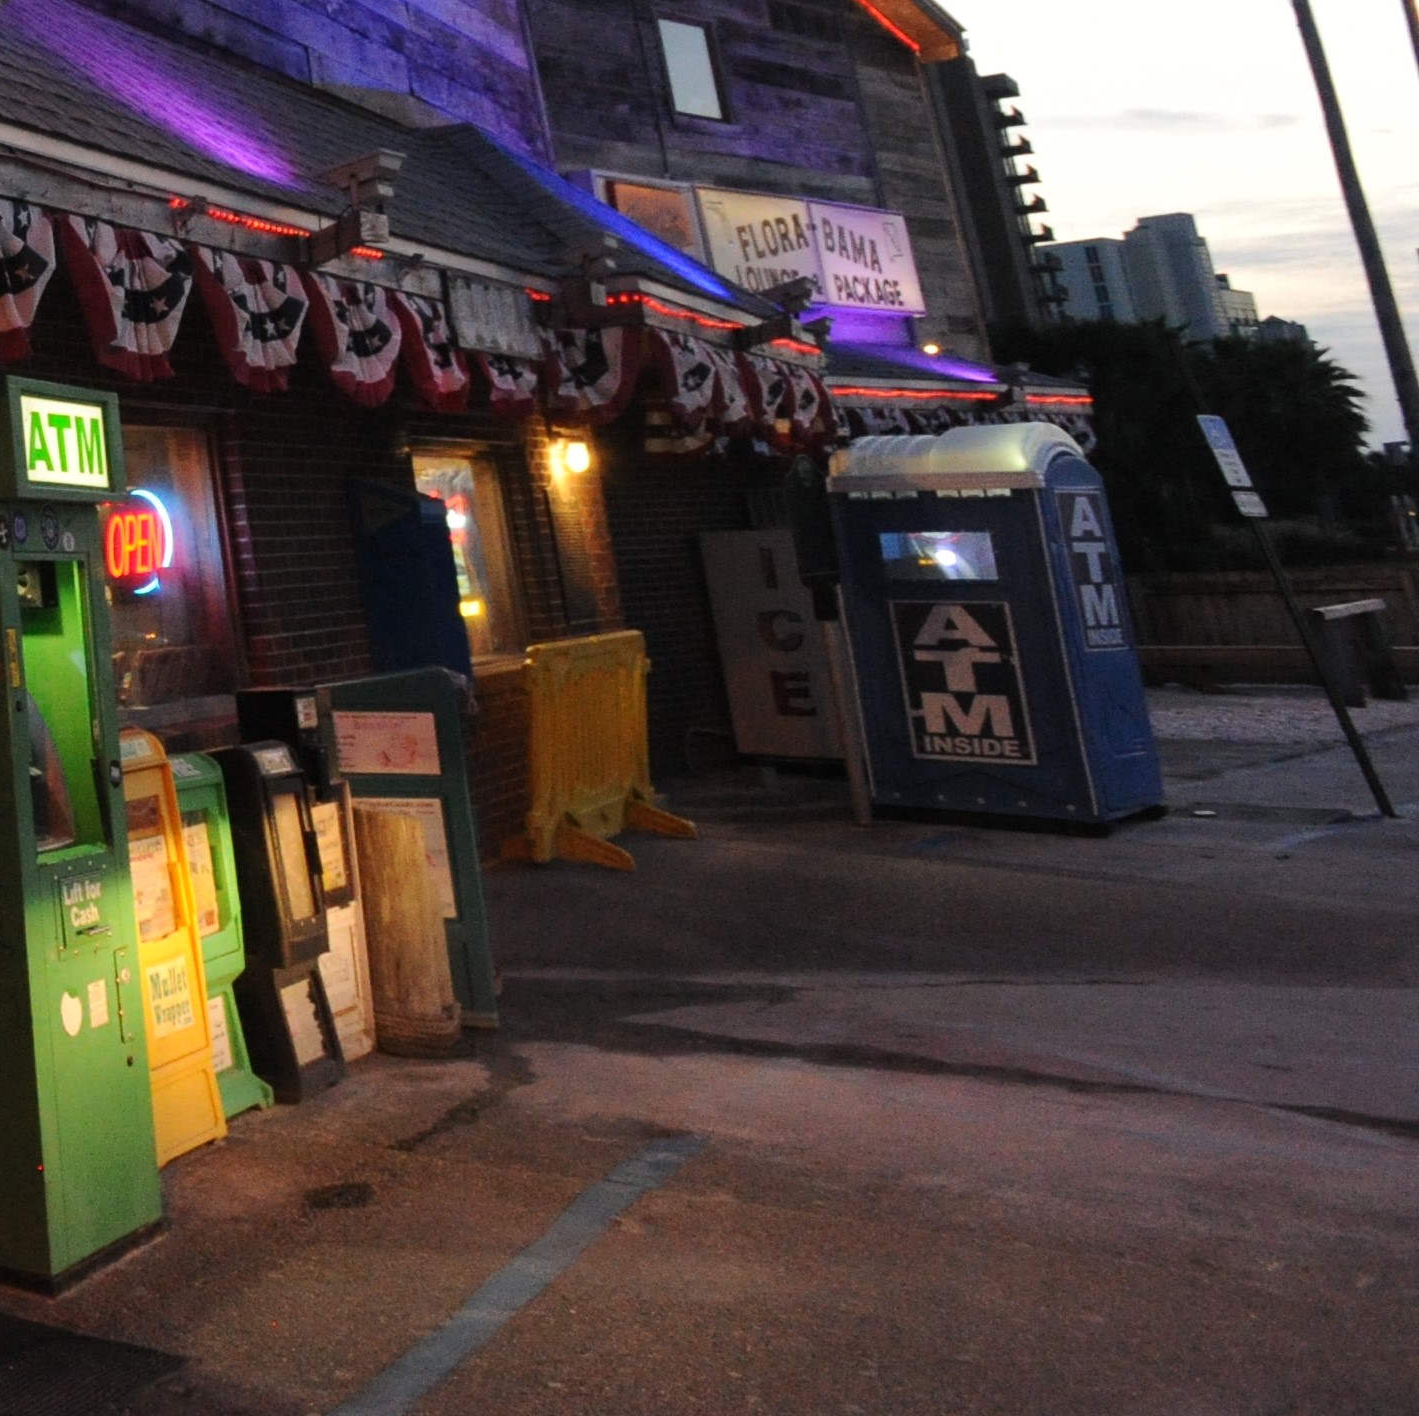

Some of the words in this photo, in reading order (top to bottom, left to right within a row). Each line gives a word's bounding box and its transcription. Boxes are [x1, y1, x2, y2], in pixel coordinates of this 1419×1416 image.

[833, 273, 905, 307] PACKAGE
[28, 410, 104, 475] ATM
[107, 512, 162, 578] OPEN
[1070, 496, 1120, 627] ATM
[757, 546, 817, 717] ICE
[913, 604, 1015, 737] ATM
[923, 737, 1022, 758] INSIDE
[63, 882, 84, 906] Lift
[85, 880, 102, 900] for
[70, 903, 100, 928] Cash
[149, 966, 188, 1002] Mullet
